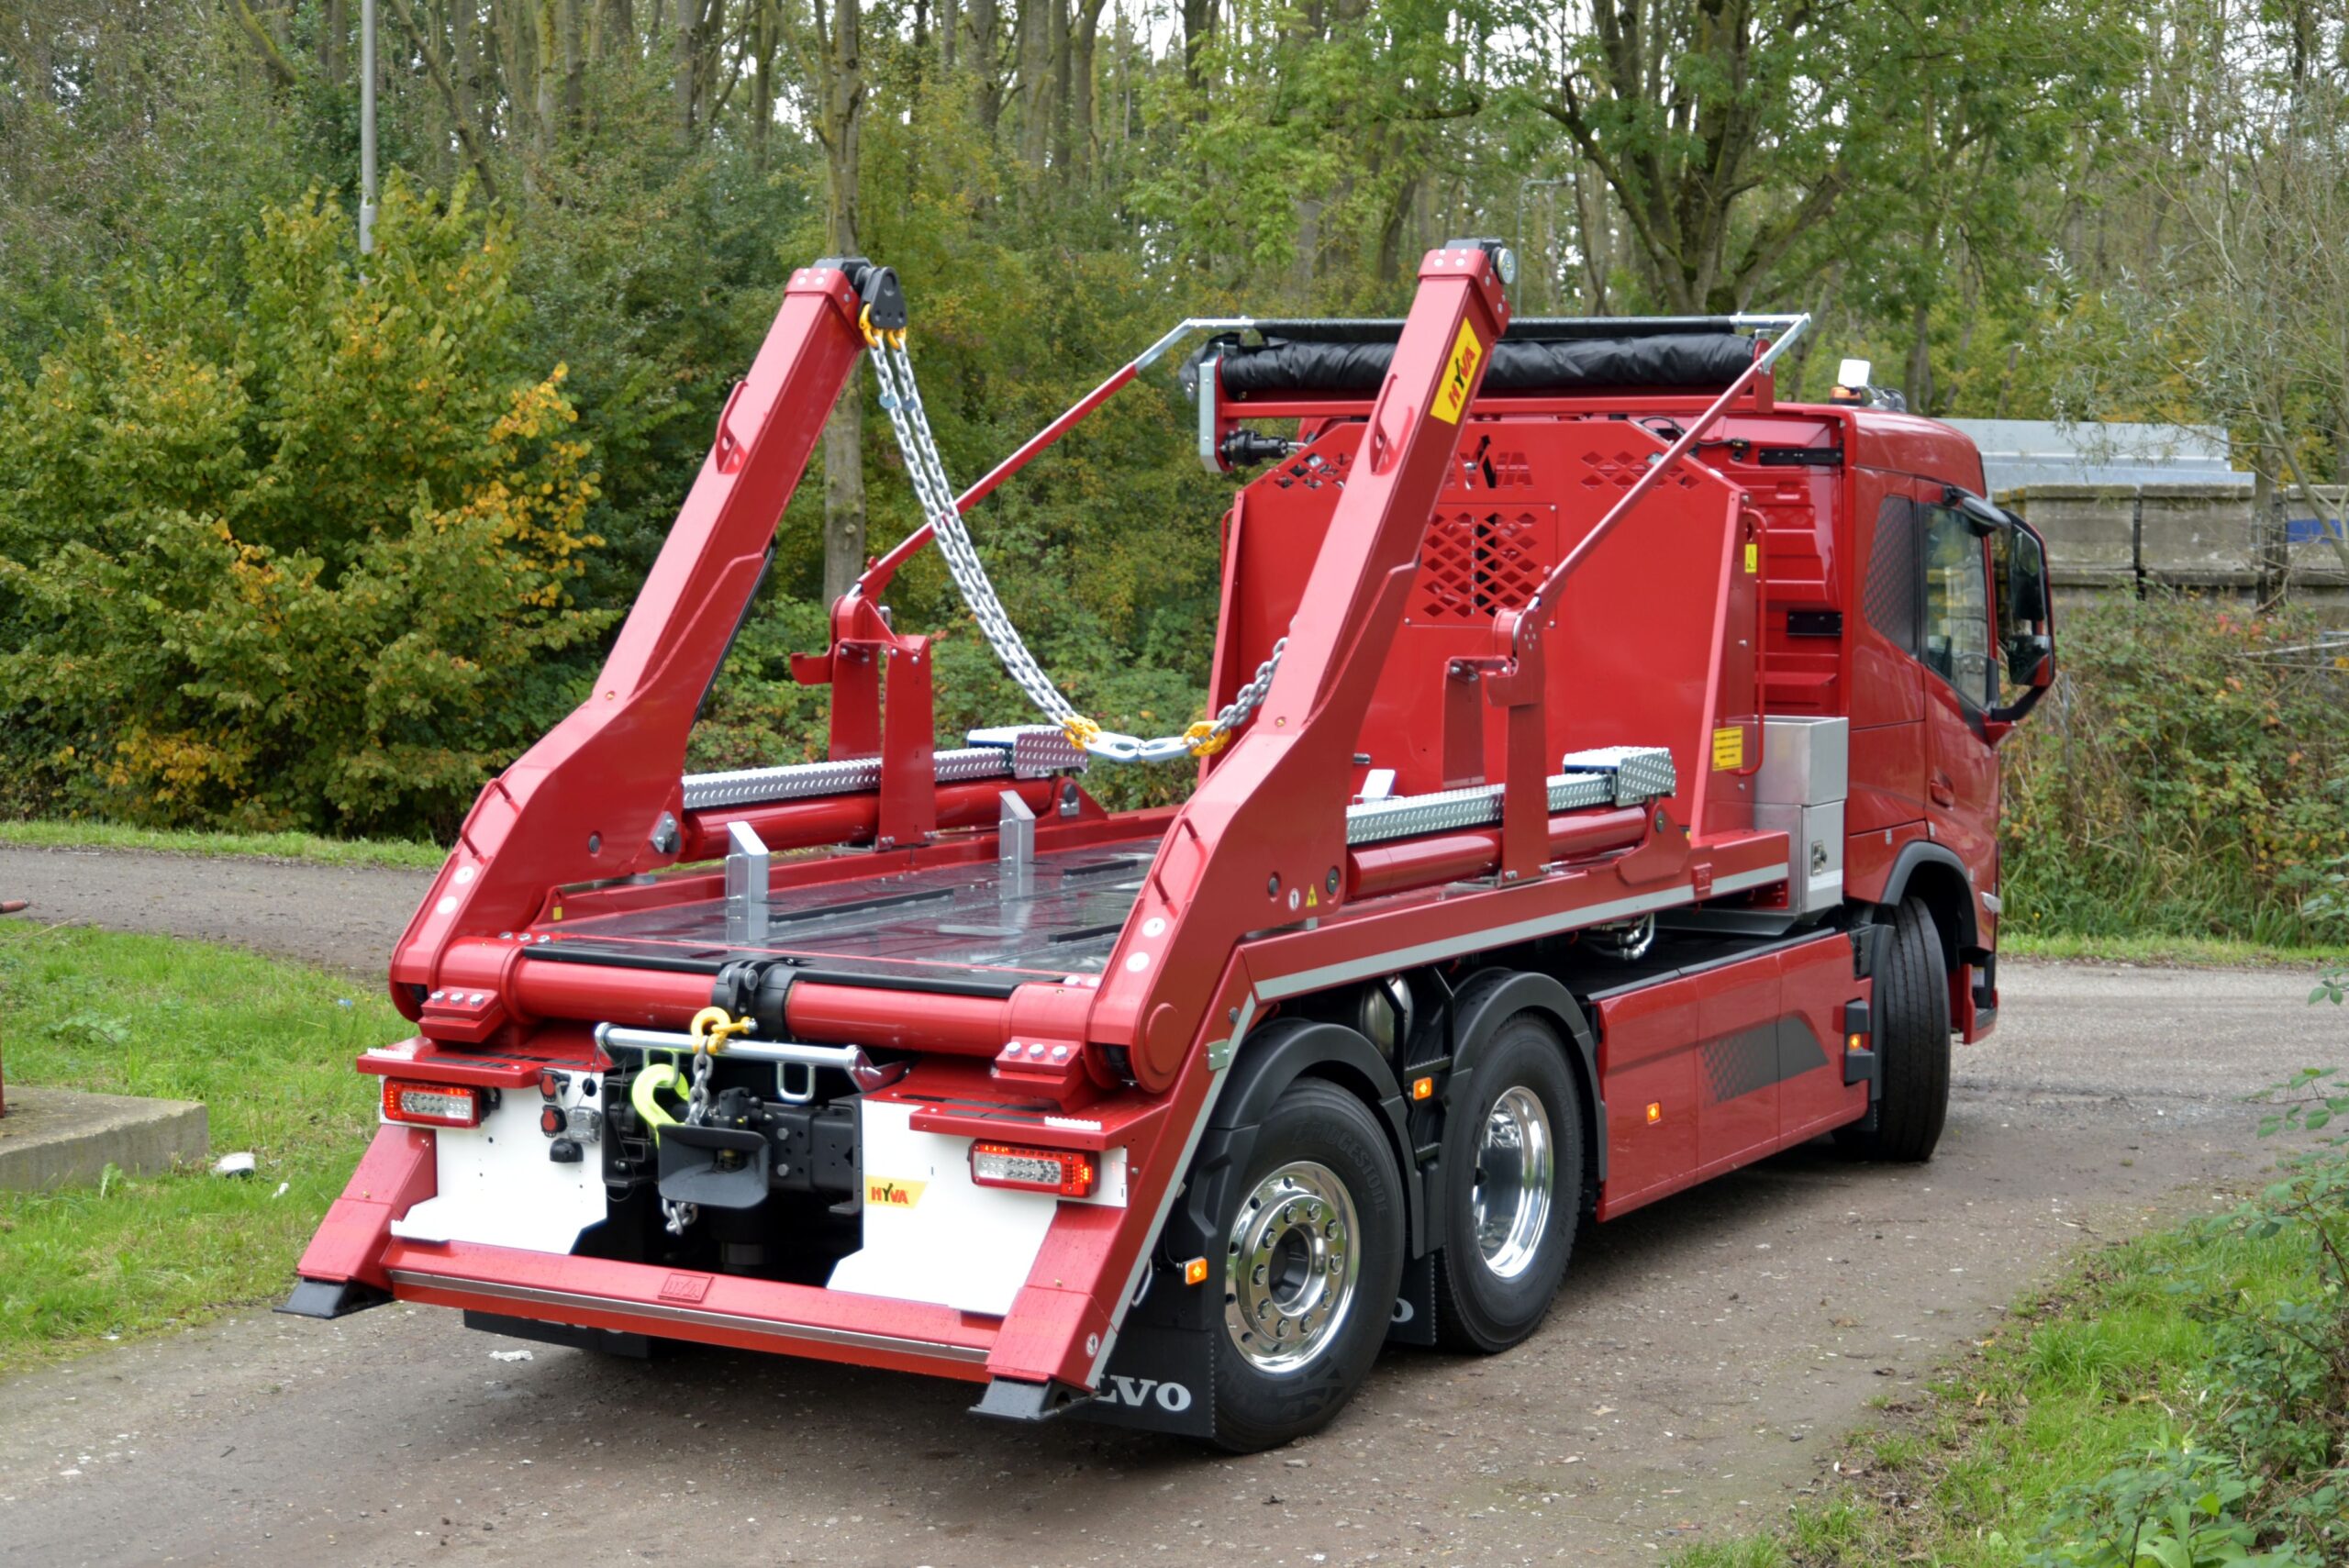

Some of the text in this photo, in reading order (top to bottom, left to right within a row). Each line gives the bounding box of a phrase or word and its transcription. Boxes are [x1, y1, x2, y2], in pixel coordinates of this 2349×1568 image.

[1447, 345, 1476, 410] HYVA
[871, 1183, 908, 1204] HYVA
[1292, 1121, 1388, 1220] BRIDGESTONE
